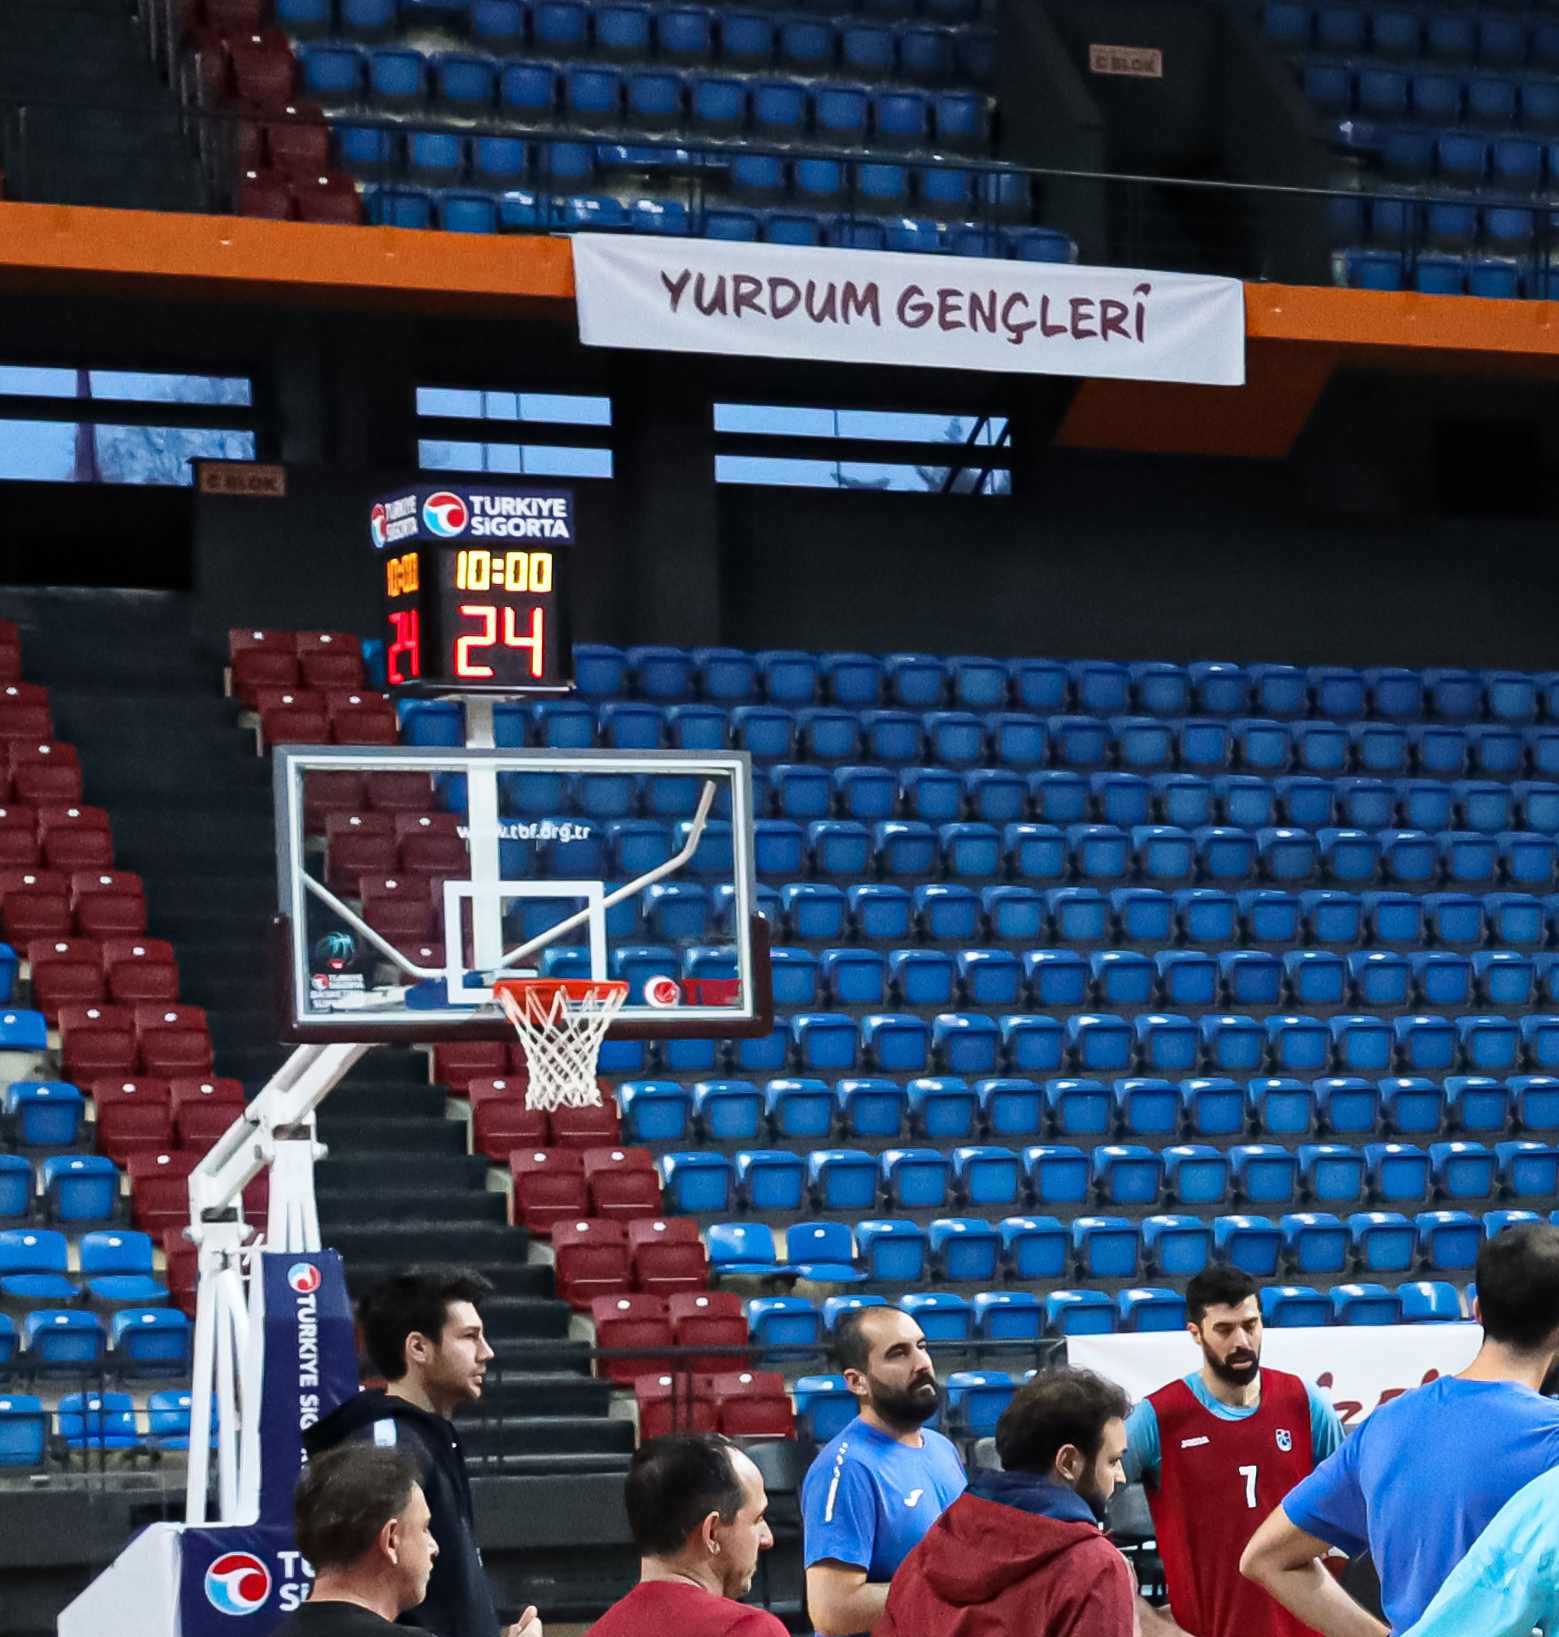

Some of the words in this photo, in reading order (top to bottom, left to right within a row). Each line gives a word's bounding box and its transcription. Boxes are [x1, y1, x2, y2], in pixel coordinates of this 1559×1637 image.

[661, 269, 881, 327] YURDUM
[896, 283, 1152, 344] GENÇLERİ
[456, 550, 552, 592] 10:00
[455, 604, 545, 680] 24
[456, 820, 591, 843] ww.tbf.org.tr
[1239, 1465, 1257, 1508] 7
